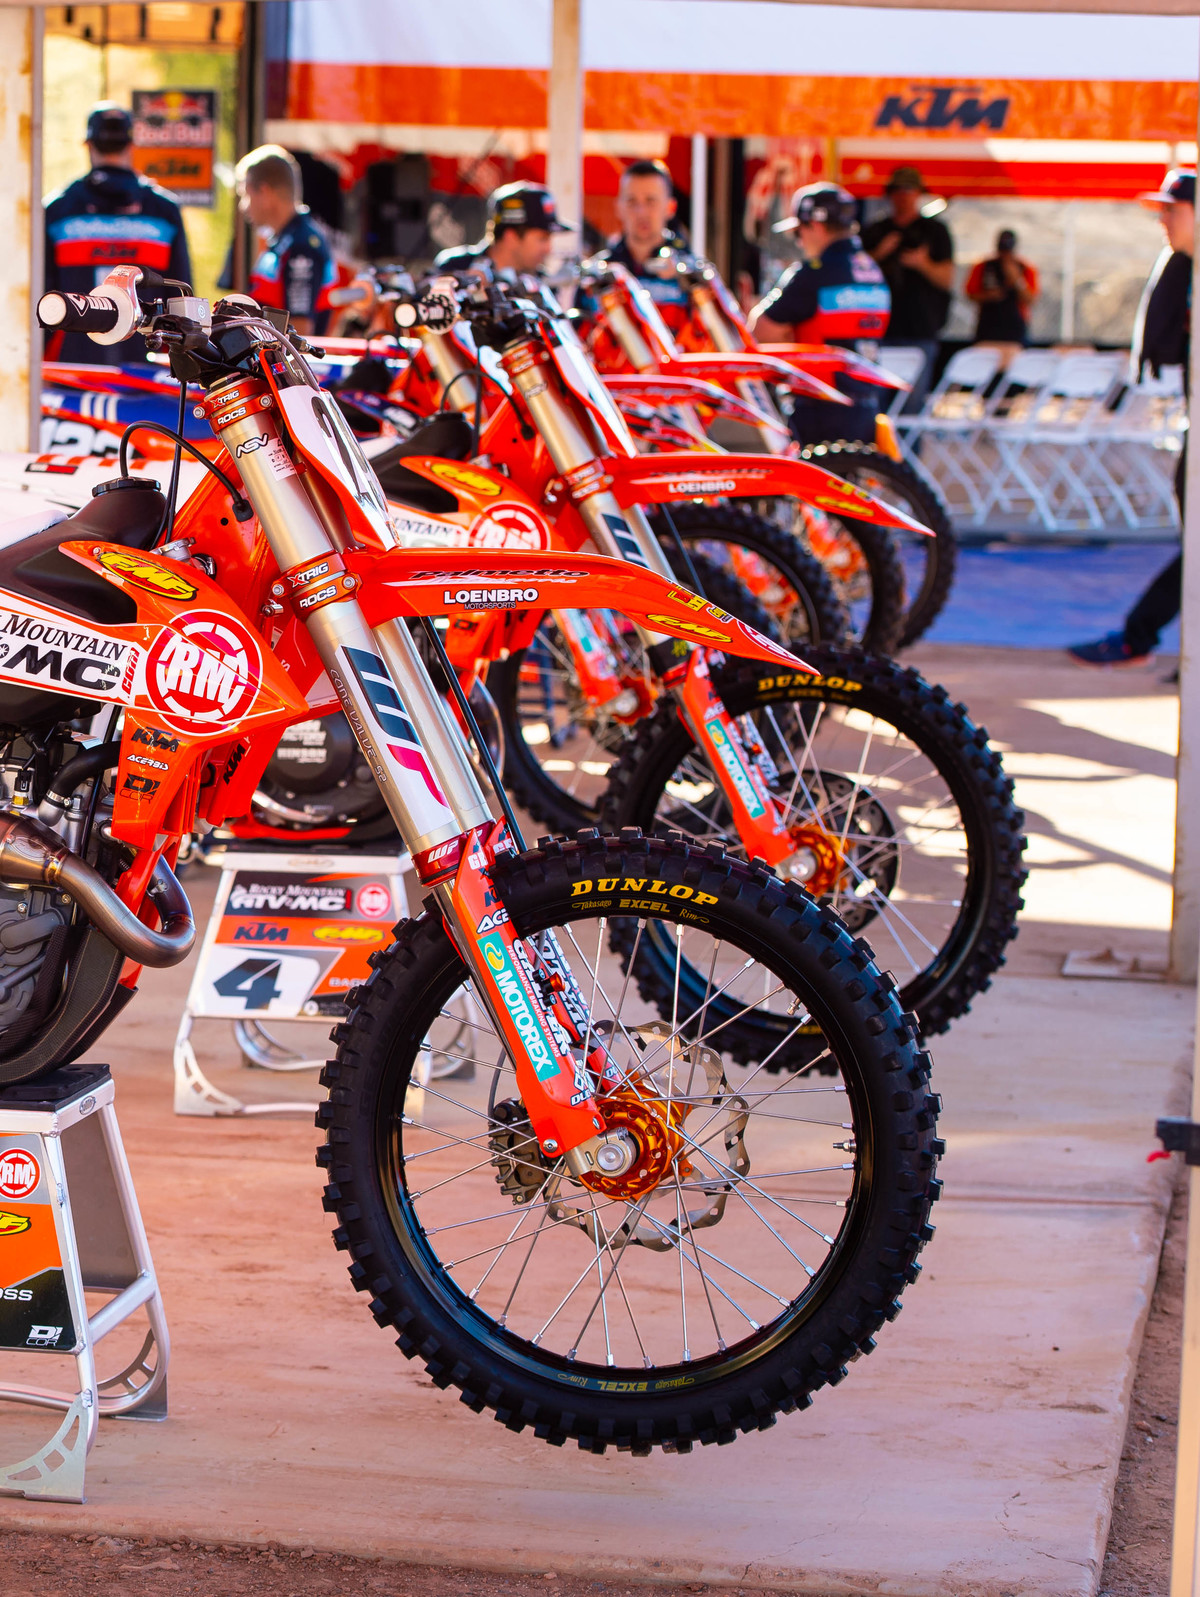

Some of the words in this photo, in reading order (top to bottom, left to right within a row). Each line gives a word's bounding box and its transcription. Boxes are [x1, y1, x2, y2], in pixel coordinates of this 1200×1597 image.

[876, 87, 1009, 130] KTM
[212, 390, 240, 408] XTRIG
[217, 406, 247, 425] ROCS
[236, 433, 268, 458] ASV
[100, 554, 199, 595] FMF
[287, 562, 329, 588] XTRIG
[300, 585, 337, 609] ROCS
[443, 588, 539, 605] LOENBRO
[464, 602, 517, 610] MOTORSPORTS
[0, 613, 128, 660] MOUNTAIN
[757, 673, 863, 692] DUNLOP
[131, 726, 181, 753] KTM
[127, 754, 169, 771] ACERBIS
[570, 878, 719, 905] DUNLOP
[619, 899, 671, 913] EXCEL
[679, 908, 710, 924] Rim
[234, 921, 290, 942] KTM
[212, 958, 282, 1010] 4
[506, 945, 533, 995] PERFORMANCE
[529, 995, 547, 1025] BRAKING
[543, 1026, 560, 1058] SYSTEMS
[495, 970, 553, 1073] MOTOREX
[2, 1162, 31, 1185] RM
[597, 1380, 648, 1392] EXCEL
